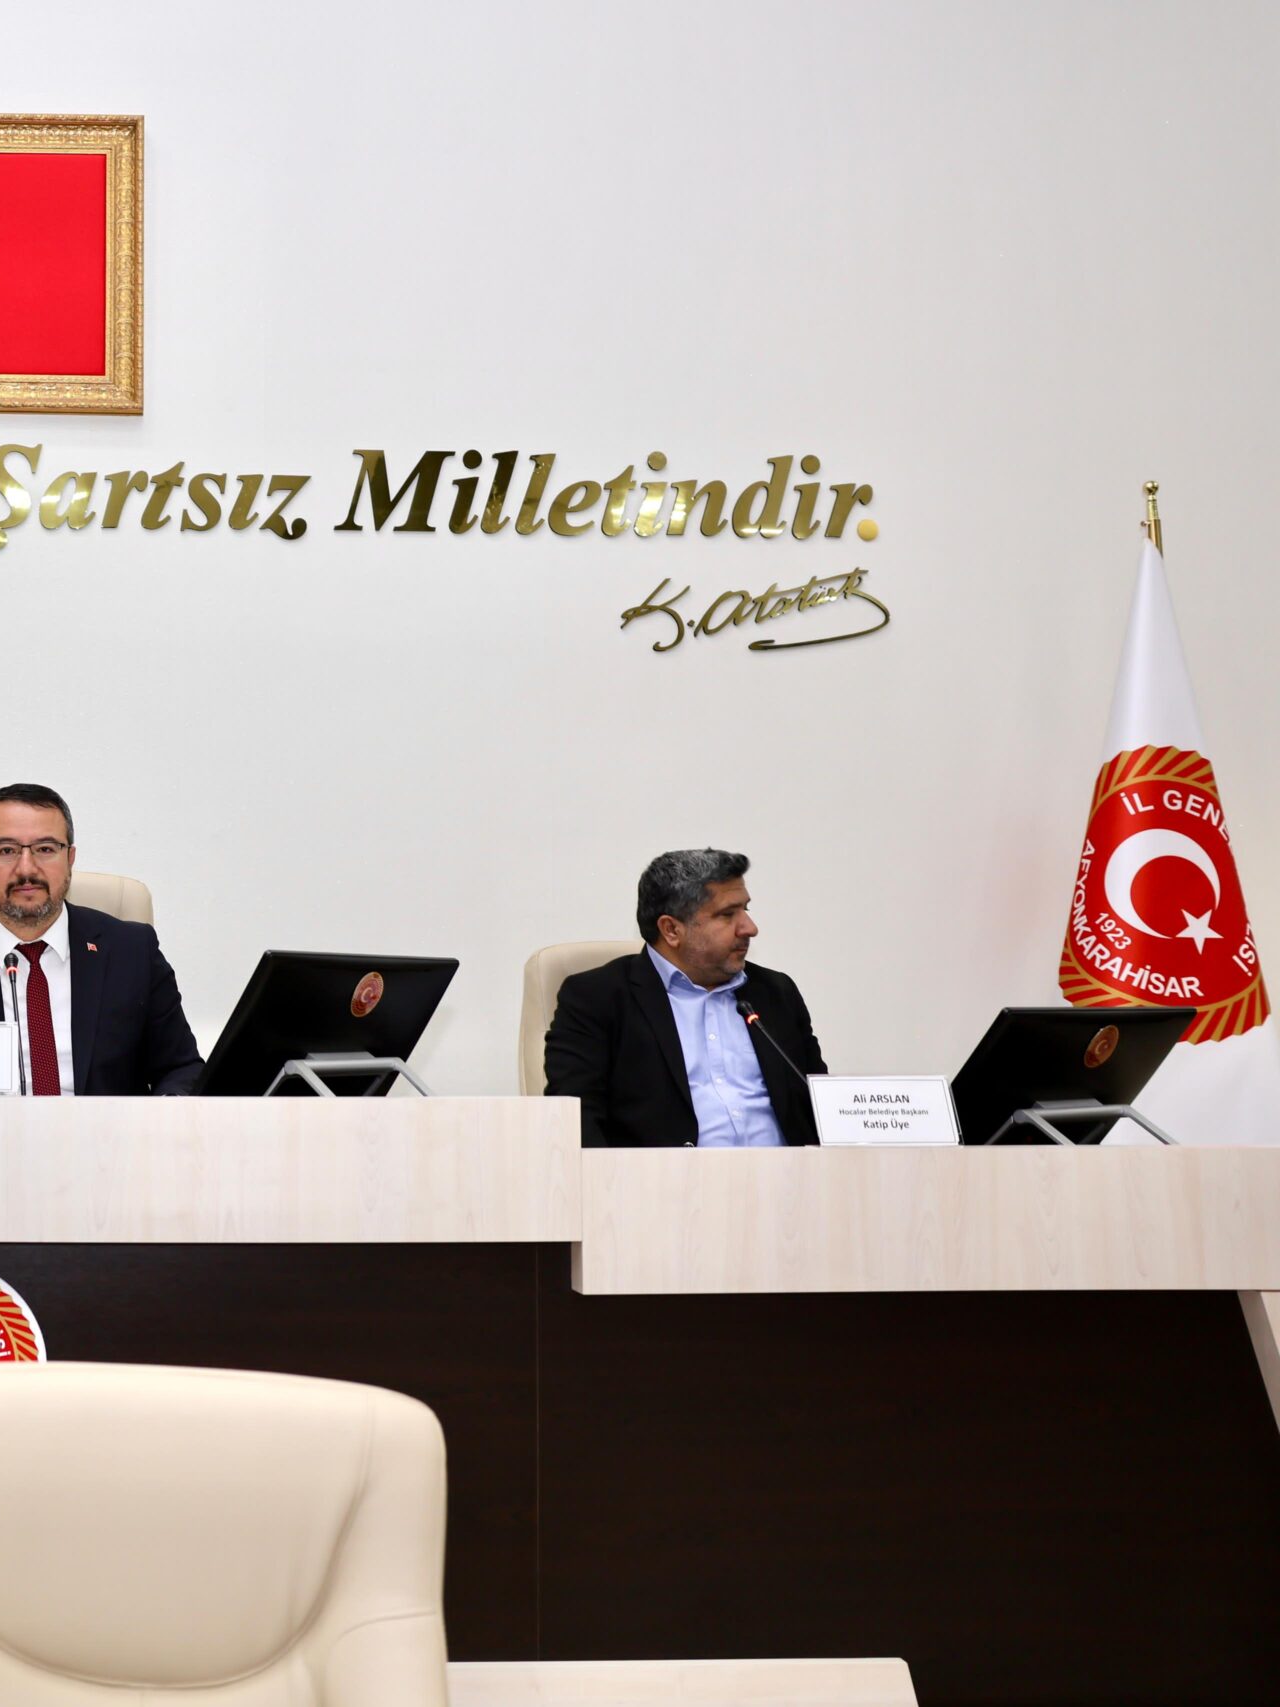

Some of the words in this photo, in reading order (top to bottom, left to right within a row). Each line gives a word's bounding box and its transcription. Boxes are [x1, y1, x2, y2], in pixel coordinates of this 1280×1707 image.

[334, 449, 878, 542] Milletindir.
[1120, 791, 1155, 815] İL
[1073, 839, 1204, 998] AFYONKARAHİSAR
[1094, 912, 1132, 950] 1923
[853, 1094, 867, 1104] Ali
[869, 1094, 910, 1104] ARSLAN
[839, 1108, 867, 1116] Hocalar
[868, 1108, 899, 1117] Belediye
[901, 1108, 929, 1117] Başkanı
[863, 1120, 889, 1130] Katip
[890, 1118, 910, 1130] Üye
